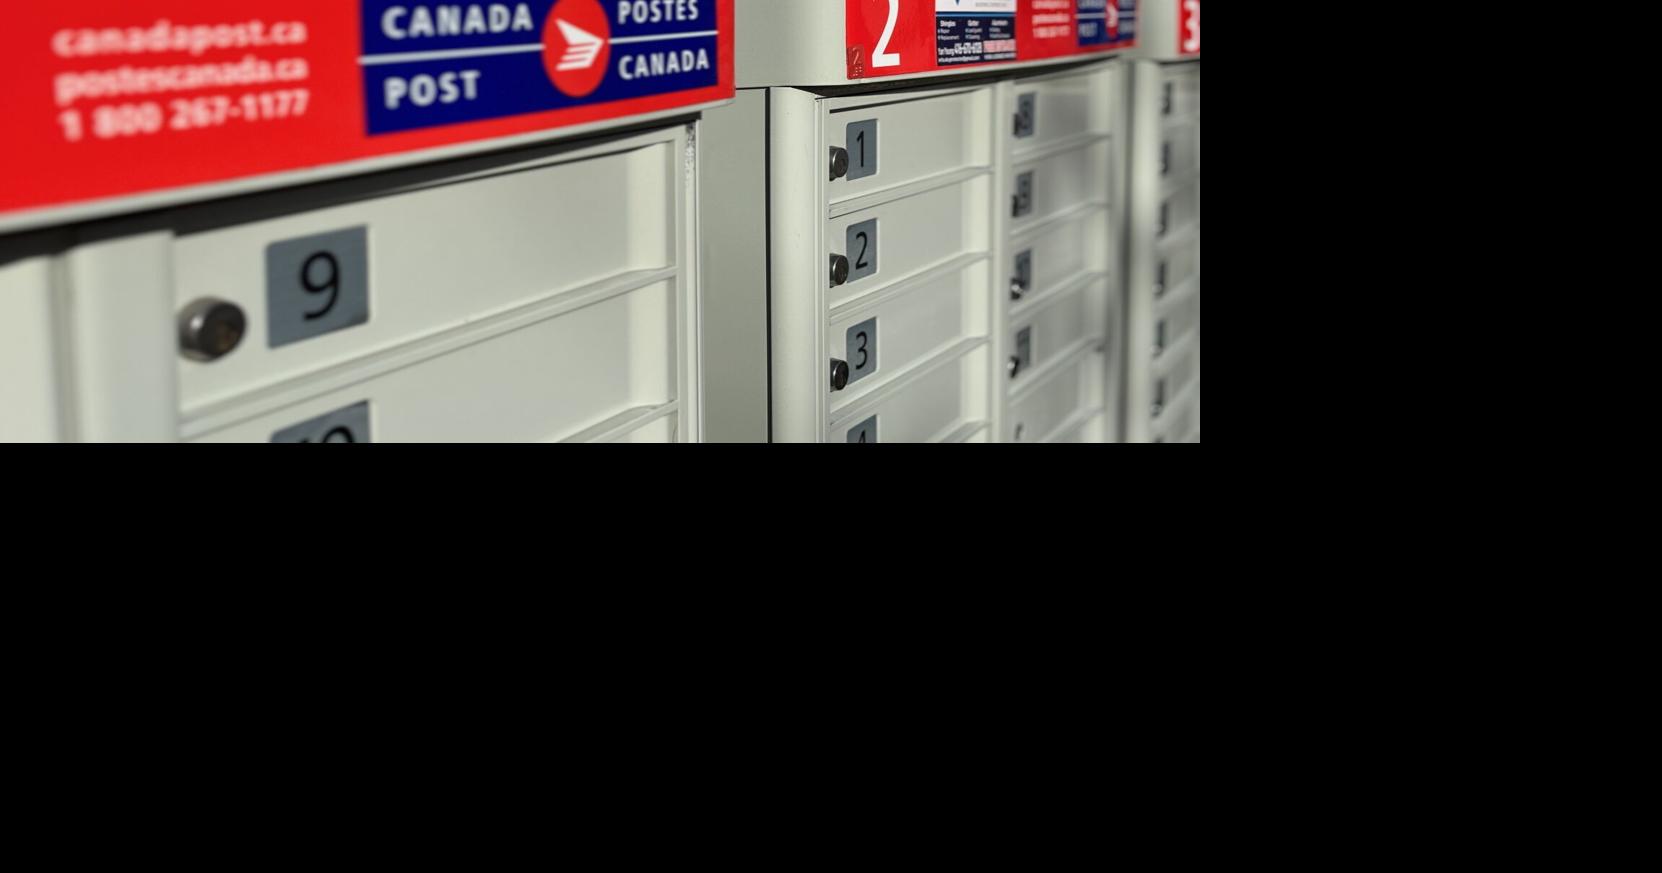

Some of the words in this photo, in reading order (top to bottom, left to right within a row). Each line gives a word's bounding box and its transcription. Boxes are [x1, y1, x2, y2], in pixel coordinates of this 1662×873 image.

[381, 3, 534, 39] CANADA
[617, 0, 699, 25] POSTES
[53, 19, 307, 57] canadapost.ca
[872, 0, 900, 68] 2
[54, 54, 309, 106] postescanada.ca
[618, 49, 710, 80] CANADA
[383, 70, 480, 110] POST
[57, 109, 83, 142] 1
[93, 102, 163, 139] 800
[169, 88, 310, 130] 267-1177
[856, 130, 865, 168] 1
[855, 231, 868, 270] 2
[300, 250, 341, 322] 9
[855, 331, 868, 370] 3
